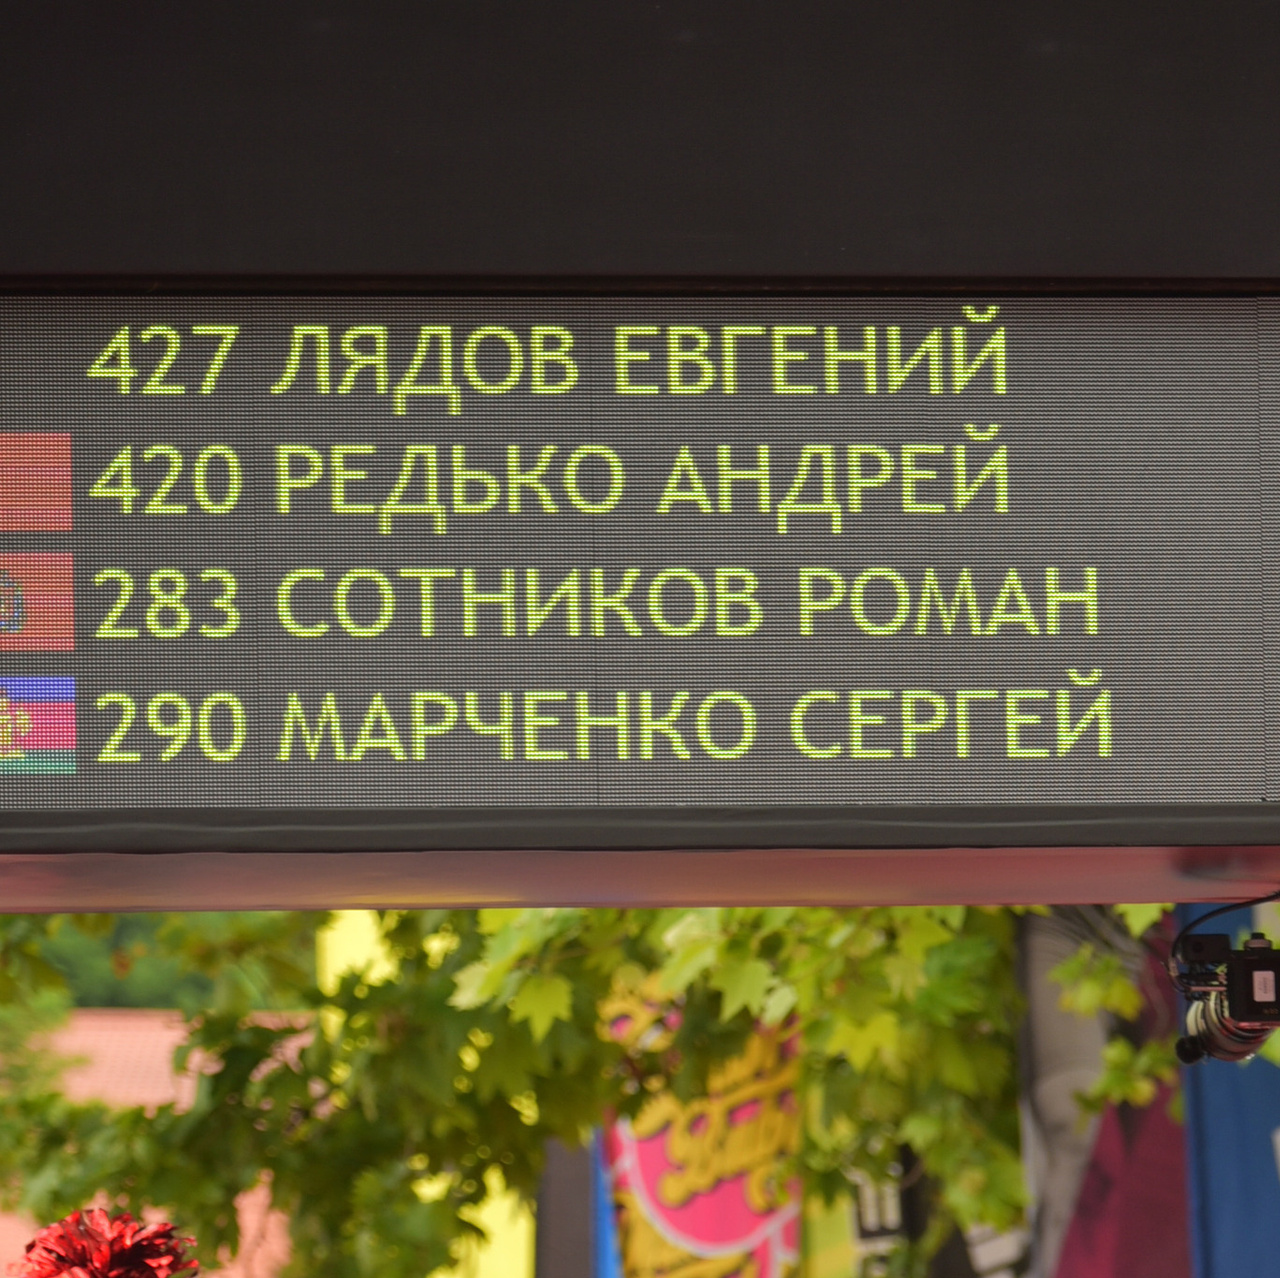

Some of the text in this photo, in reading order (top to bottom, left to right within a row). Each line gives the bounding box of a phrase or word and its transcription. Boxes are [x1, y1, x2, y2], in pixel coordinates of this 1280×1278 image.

[87, 325, 239, 394] 427
[271, 325, 580, 415] ЛЯДОВ
[614, 305, 1008, 394] ЕВГЕНИЙ
[89, 445, 242, 514] 420
[275, 444, 625, 534] РЕДЬКО
[656, 423, 1009, 532] АНДРЕЙ
[93, 568, 241, 637] 283
[276, 567, 764, 637] СОТНИКОВ
[800, 566, 1099, 636] РОМАН
[96, 692, 247, 761] 290
[276, 690, 757, 761] МАРЧЕНКО
[790, 668, 1113, 761] СЕРГЕЙ
